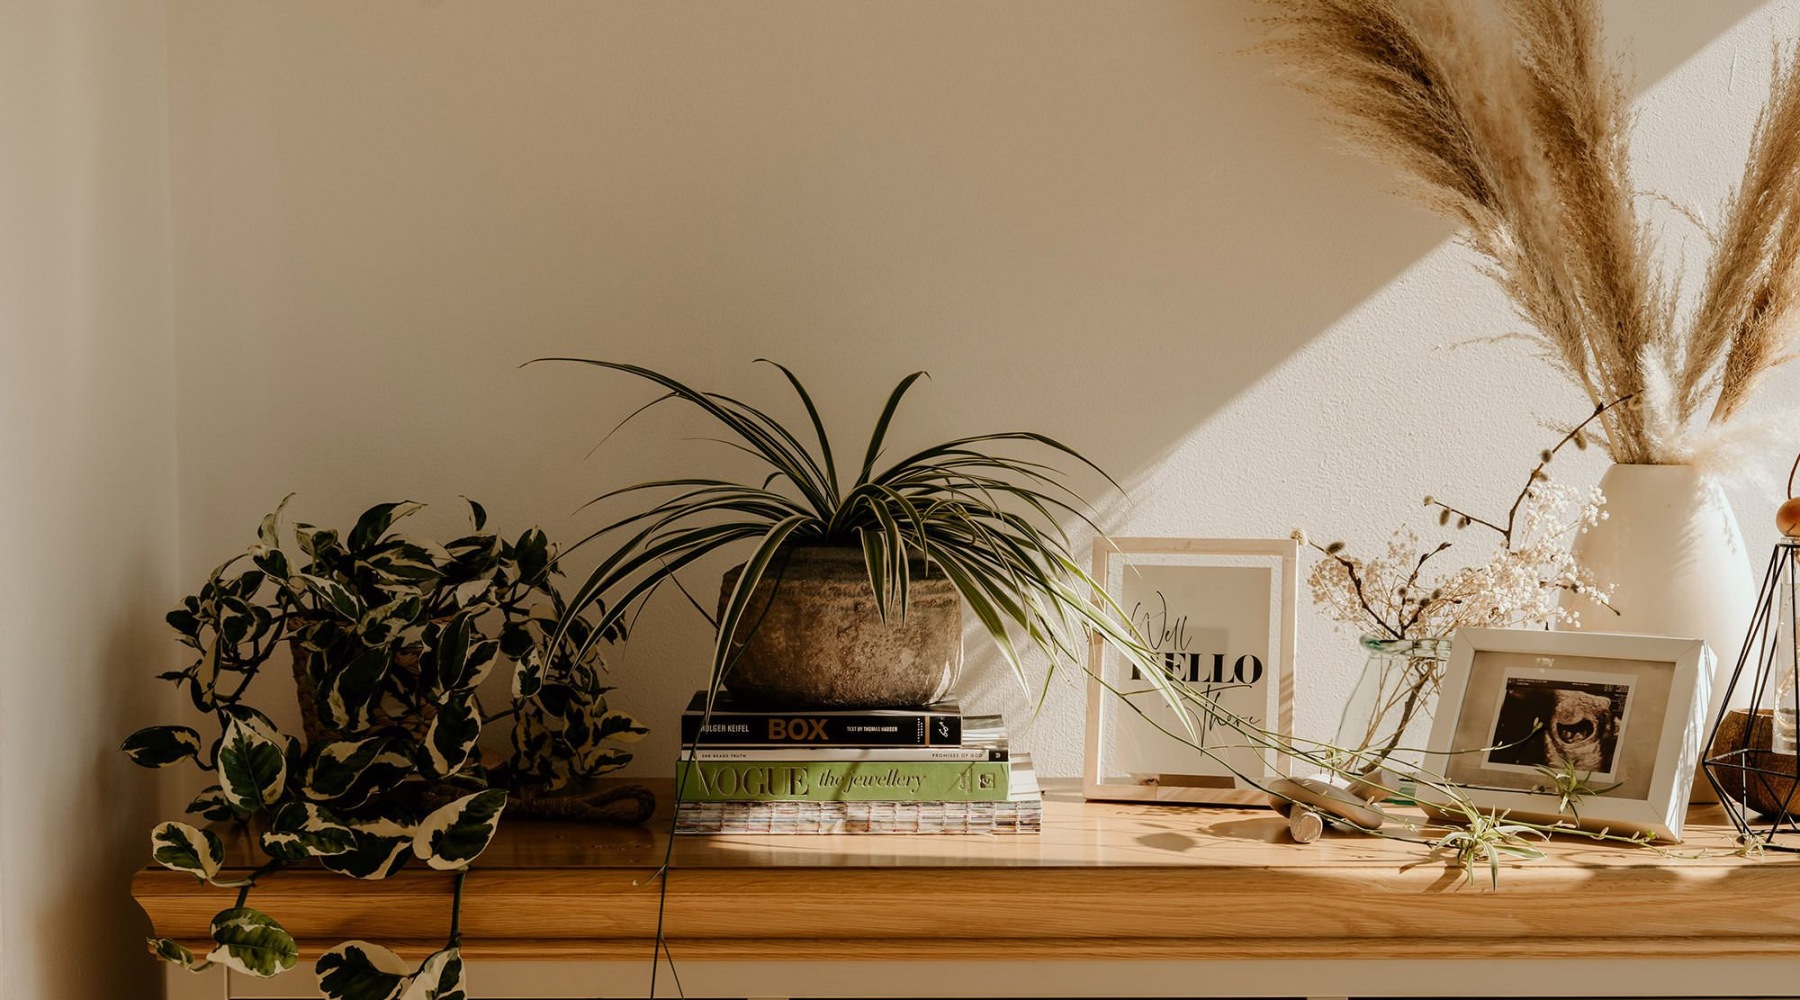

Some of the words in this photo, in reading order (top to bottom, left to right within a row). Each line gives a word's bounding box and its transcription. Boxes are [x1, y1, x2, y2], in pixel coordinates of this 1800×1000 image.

[1128, 590, 1193, 651] Well
[727, 724, 749, 733] KEIFEL
[768, 718, 829, 741] BOX
[698, 765, 809, 797] VOGUE
[817, 769, 844, 788] the
[843, 769, 924, 794] jewellery
